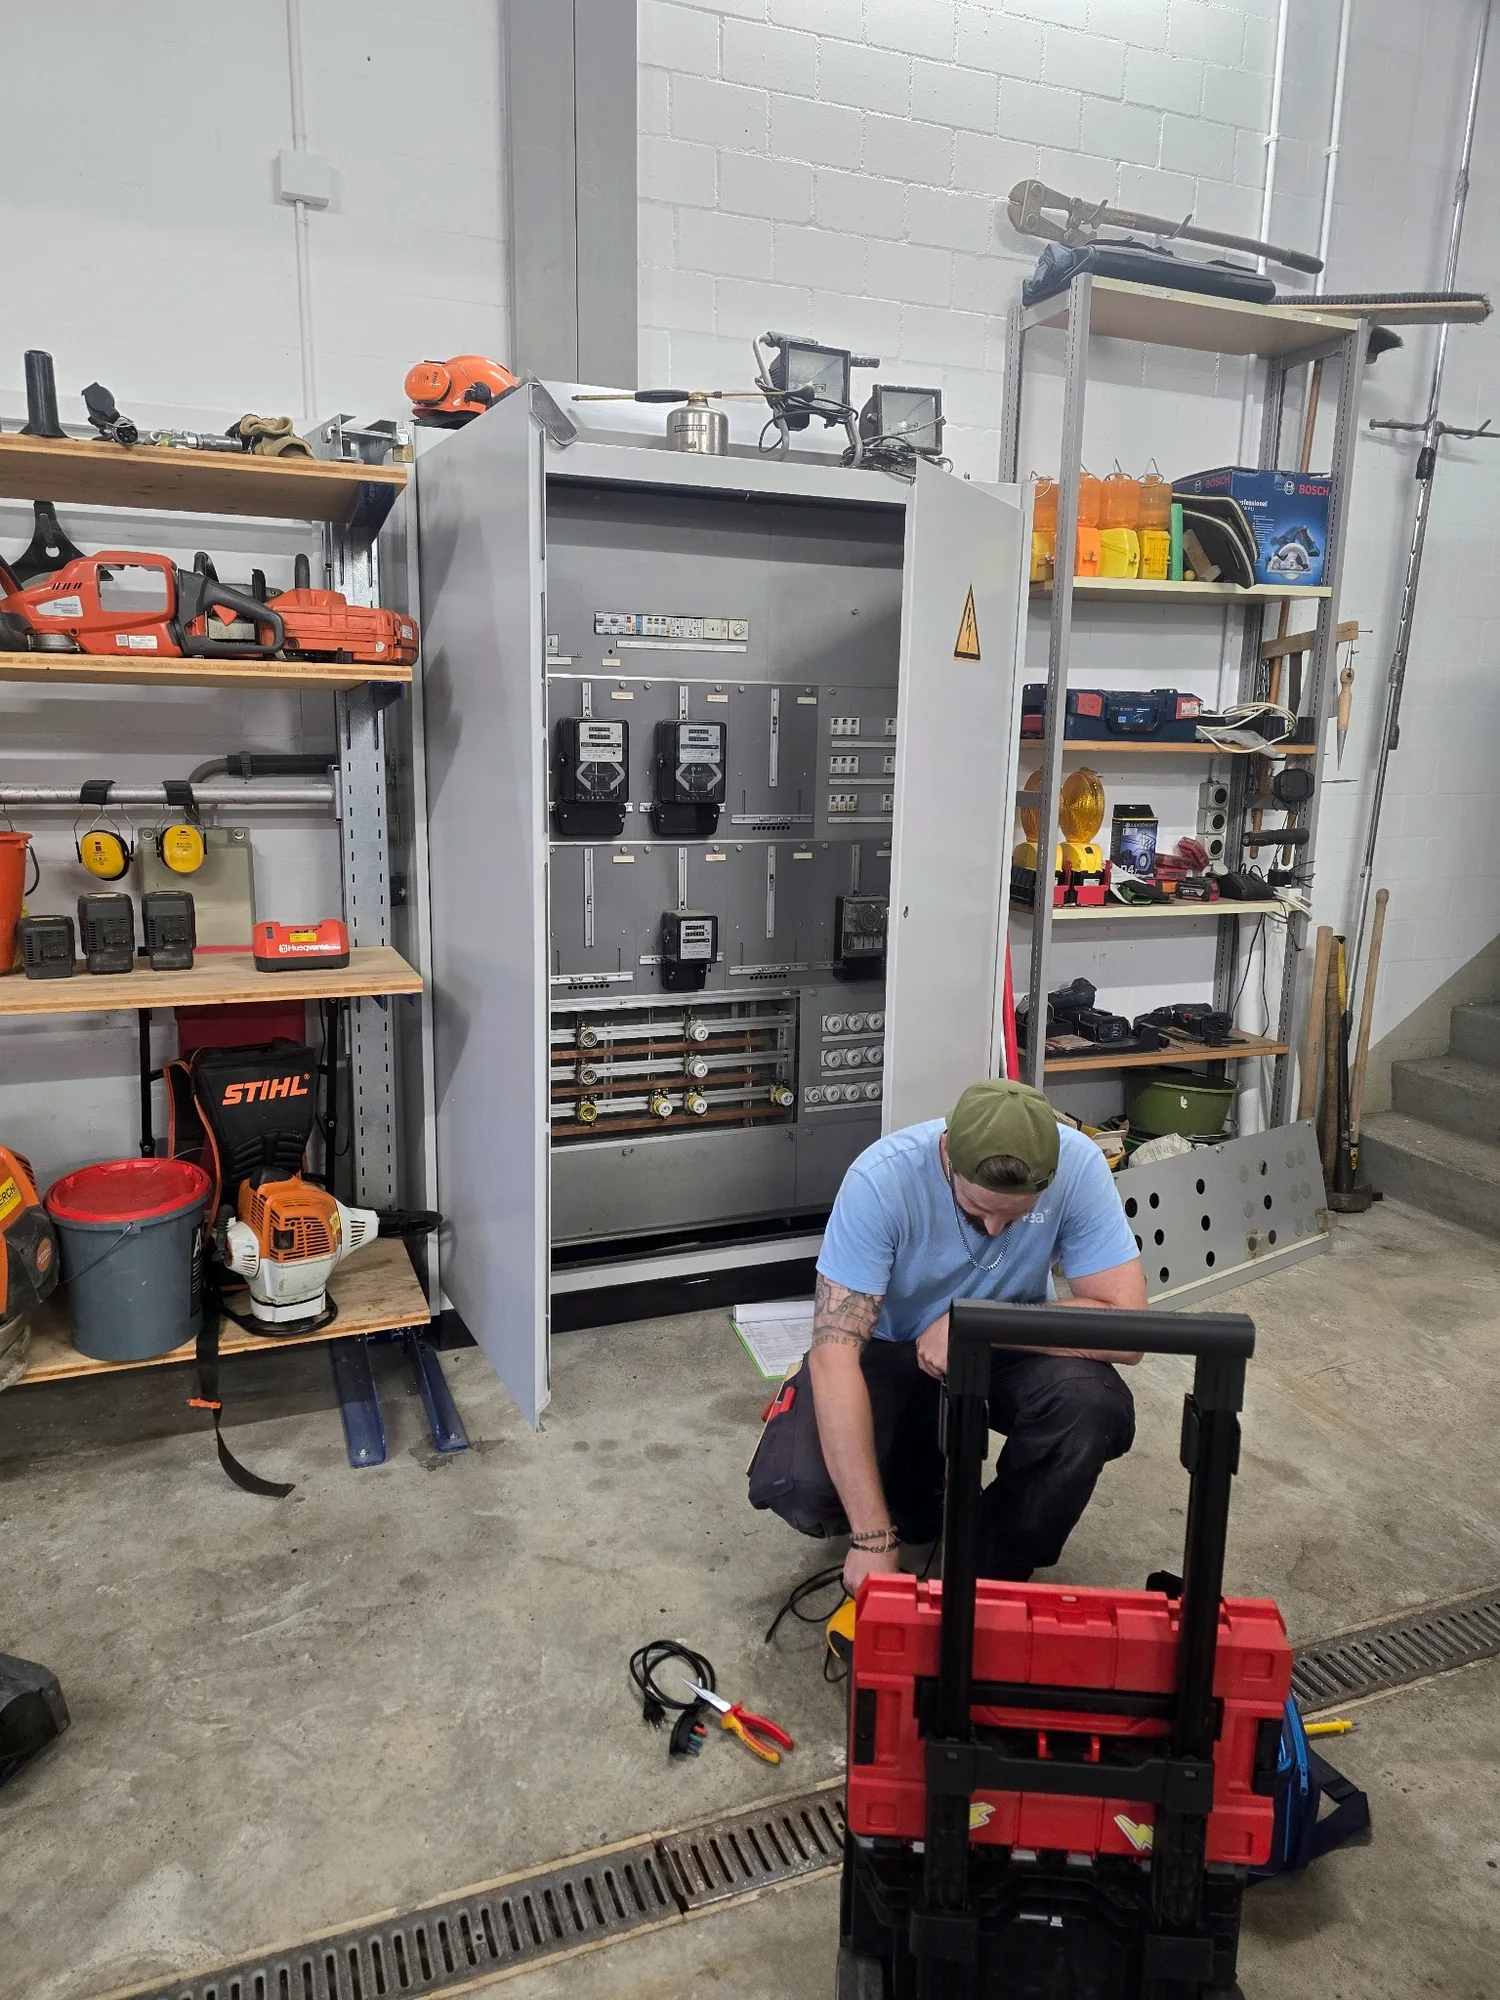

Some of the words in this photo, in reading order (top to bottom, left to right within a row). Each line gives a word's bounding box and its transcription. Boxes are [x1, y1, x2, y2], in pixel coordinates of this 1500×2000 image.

[1205, 476, 1231, 489] BOSCH
[1298, 484, 1330, 496] BOSCH
[222, 1075, 308, 1106] STIHL
